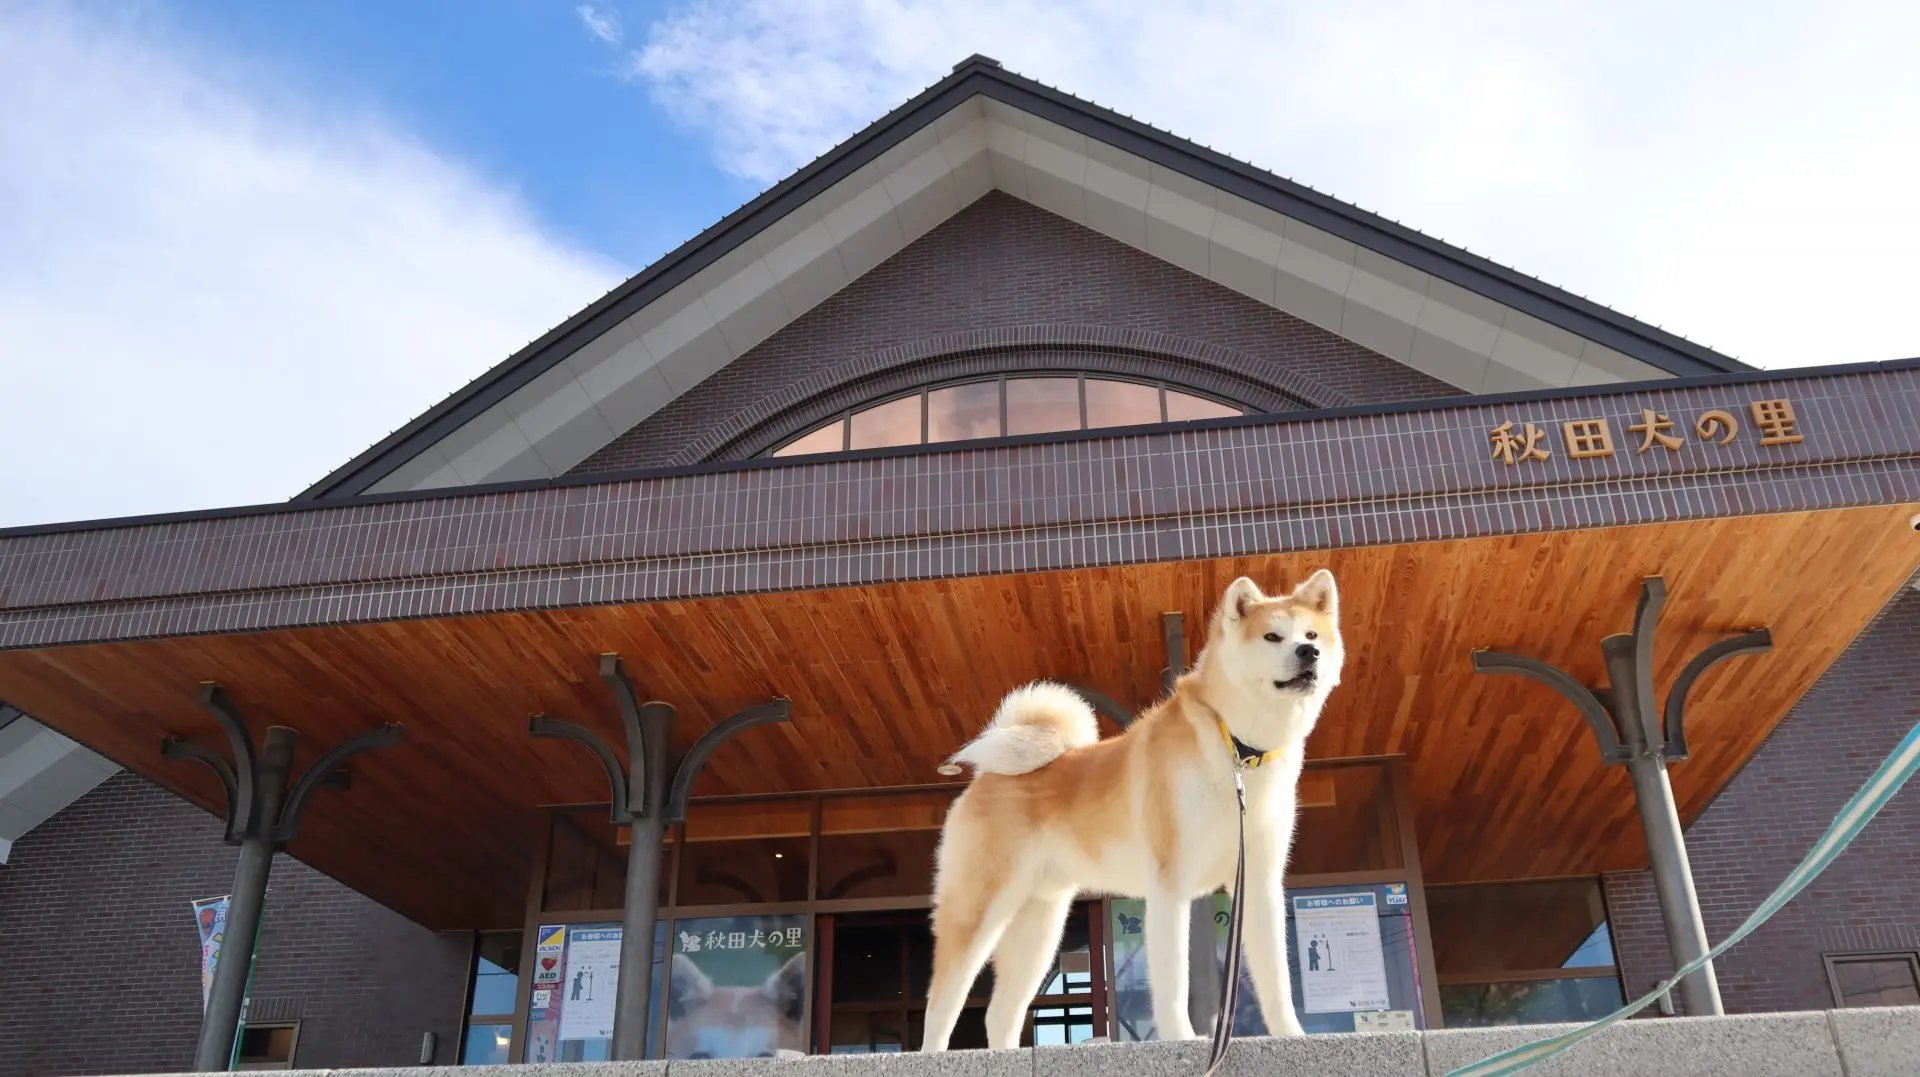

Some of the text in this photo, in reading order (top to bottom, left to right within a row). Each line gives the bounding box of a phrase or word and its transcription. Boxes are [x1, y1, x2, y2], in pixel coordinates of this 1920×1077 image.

[1490, 399, 1805, 465] 秋田犬の里
[704, 927, 802, 949] 秋田犬の里
